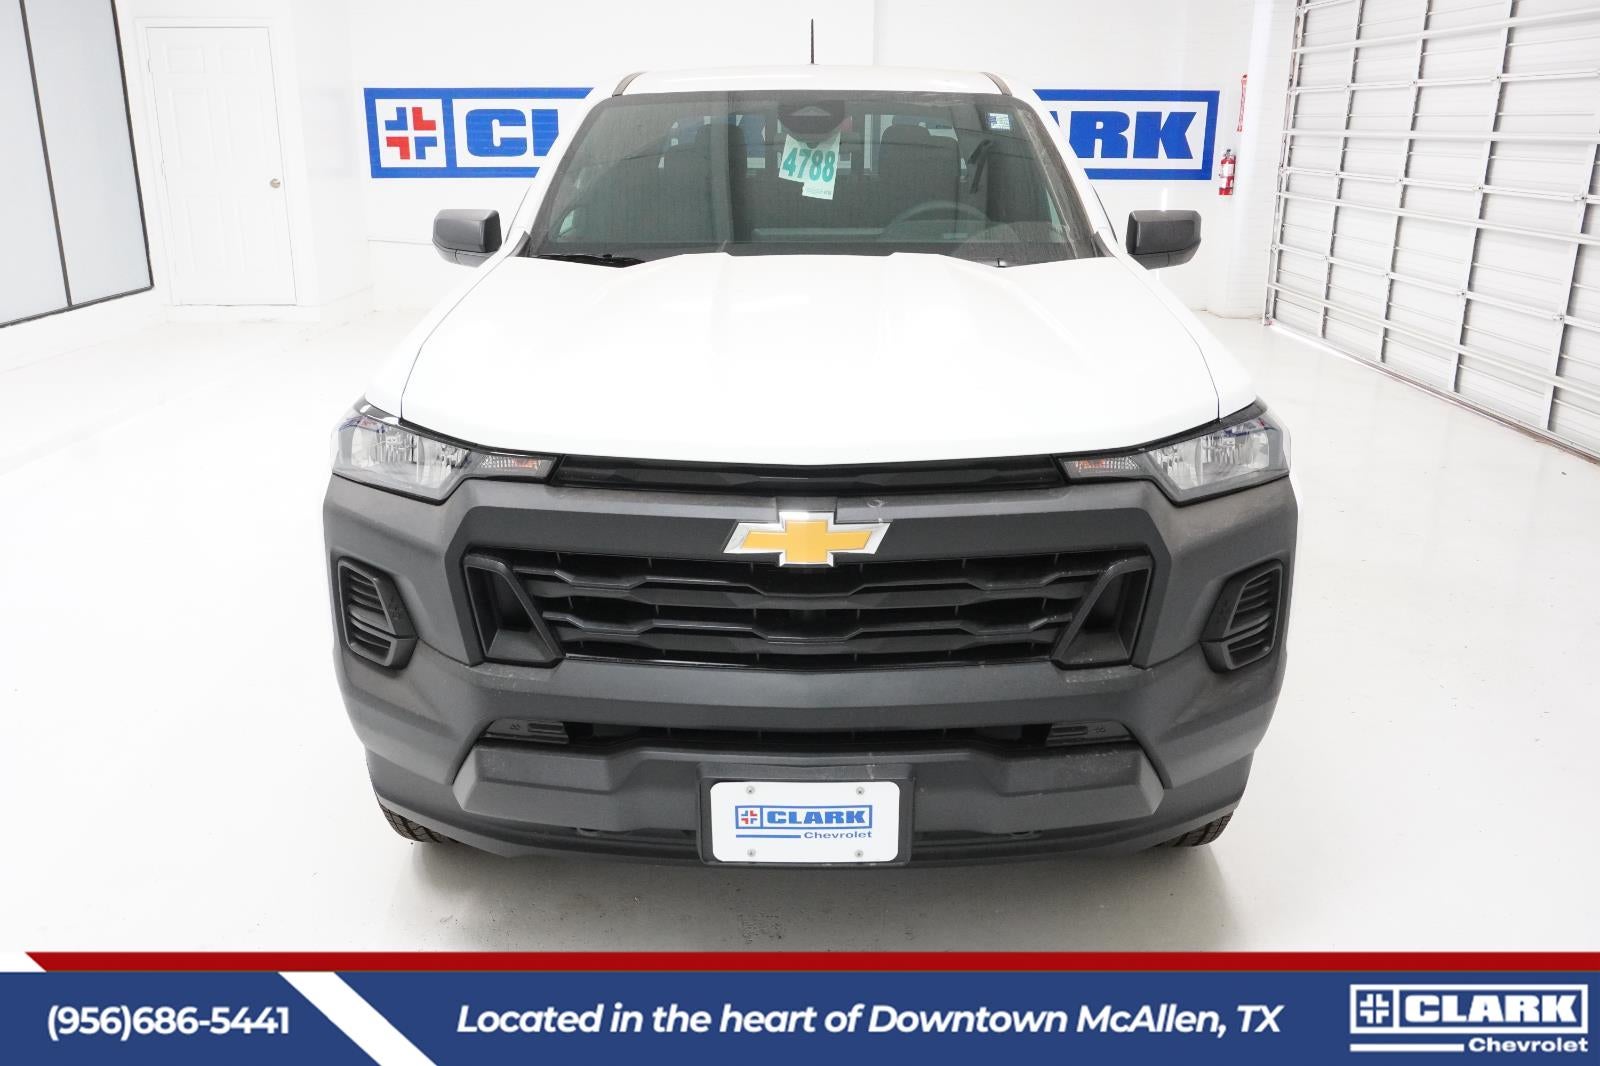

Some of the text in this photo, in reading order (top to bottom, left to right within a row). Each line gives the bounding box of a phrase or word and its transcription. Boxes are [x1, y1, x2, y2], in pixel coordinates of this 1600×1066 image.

[465, 108, 560, 157] CL
[1050, 110, 1197, 159] RK
[782, 147, 837, 183] 4788
[766, 810, 865, 825] CLARK
[803, 830, 873, 840] Chevrolet
